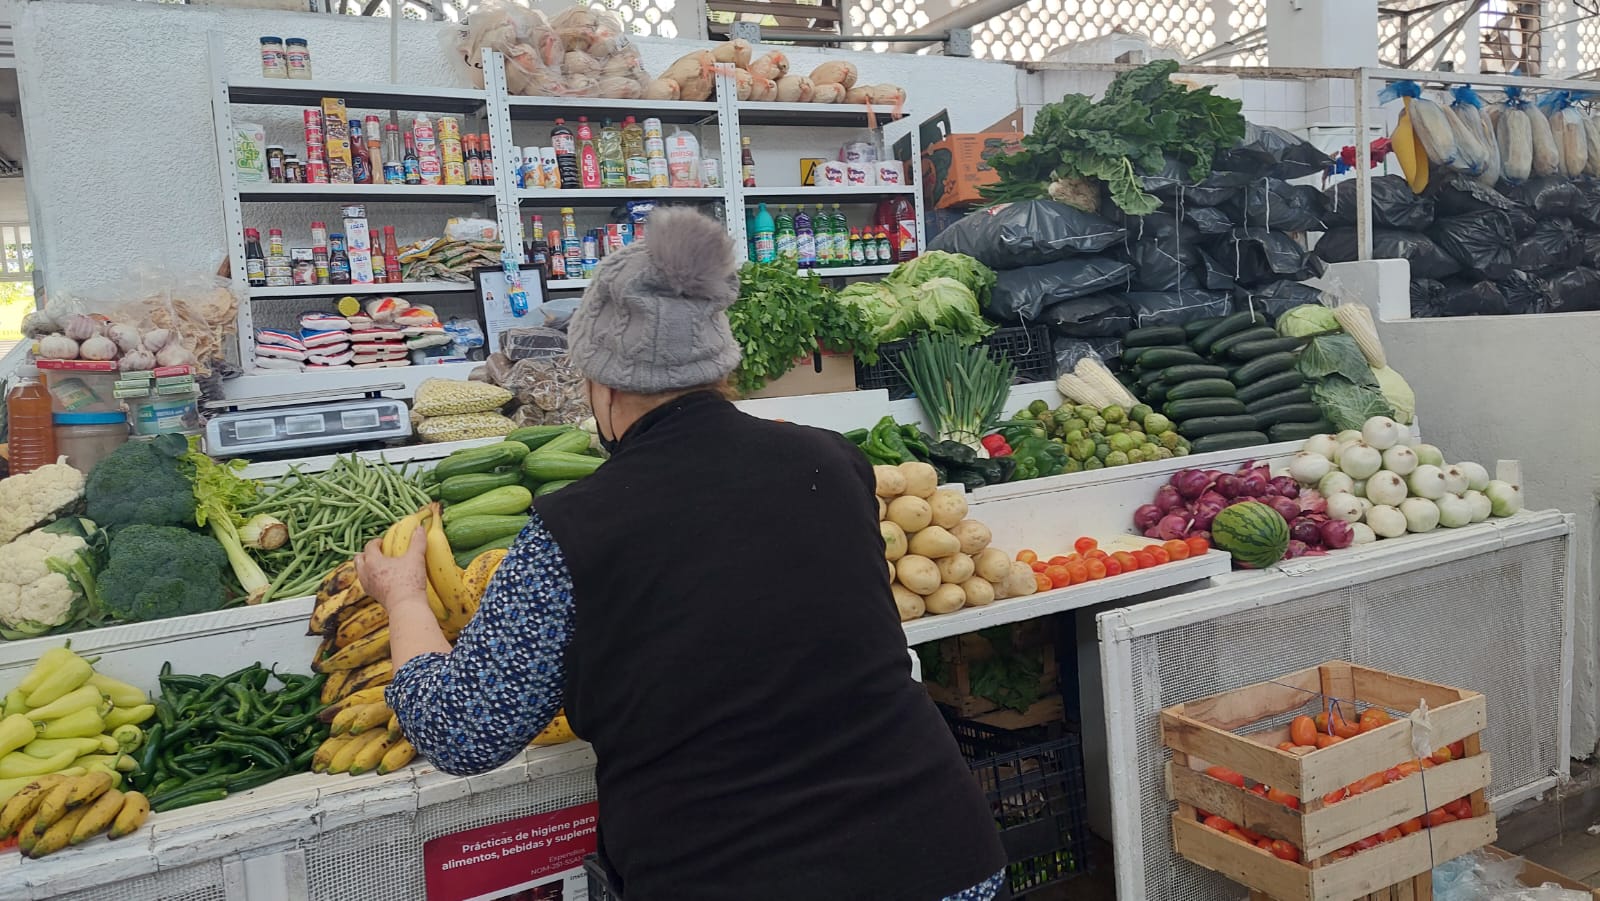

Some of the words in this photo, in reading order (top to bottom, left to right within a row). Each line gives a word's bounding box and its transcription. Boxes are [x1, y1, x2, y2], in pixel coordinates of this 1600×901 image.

[585, 153, 595, 182] Capullo
[462, 836, 513, 853] Prácticas
[515, 831, 529, 841] de
[531, 823, 570, 837] higiene
[572, 816, 595, 828] para
[442, 852, 500, 870] alimentos,
[502, 840, 544, 856] bebidas
[546, 838, 552, 847] y
